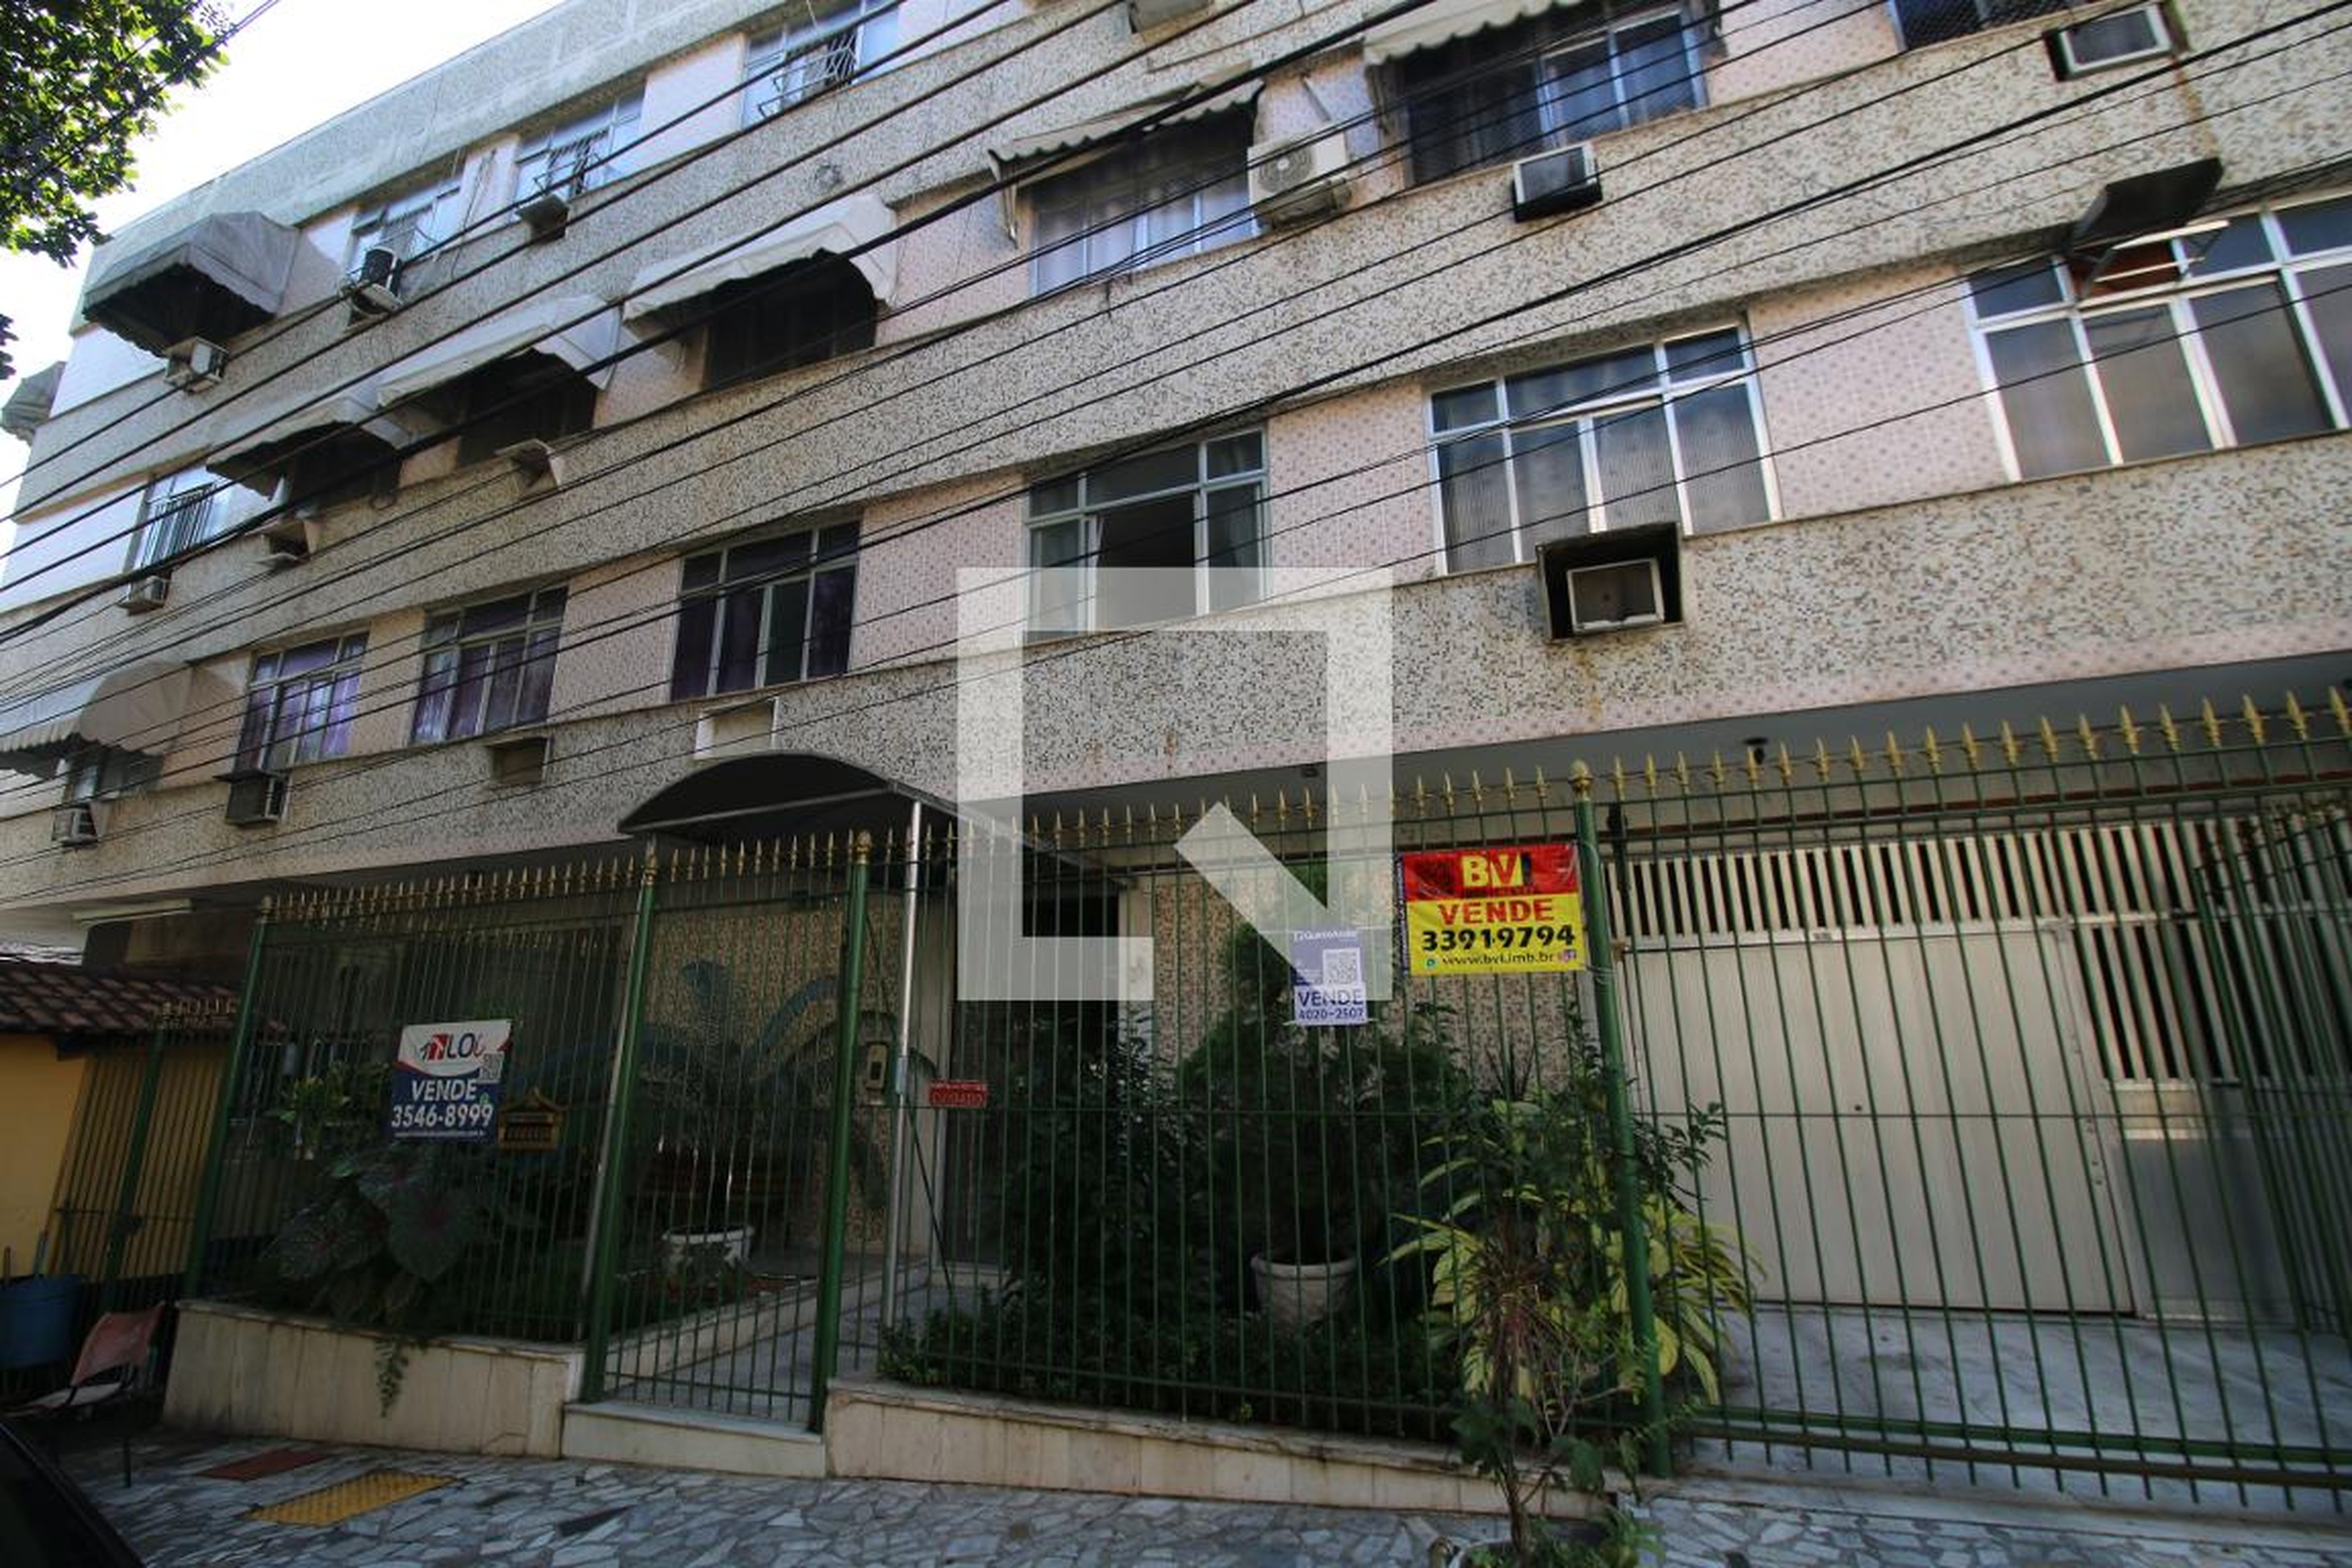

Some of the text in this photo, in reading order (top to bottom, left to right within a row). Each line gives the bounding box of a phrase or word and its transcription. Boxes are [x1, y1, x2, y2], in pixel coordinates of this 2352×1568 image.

[1438, 899, 1555, 925] VENDE
[1298, 989, 1363, 1007] VENDE
[412, 1079, 477, 1101] VENDE
[391, 1104, 494, 1128] 3546-8999
